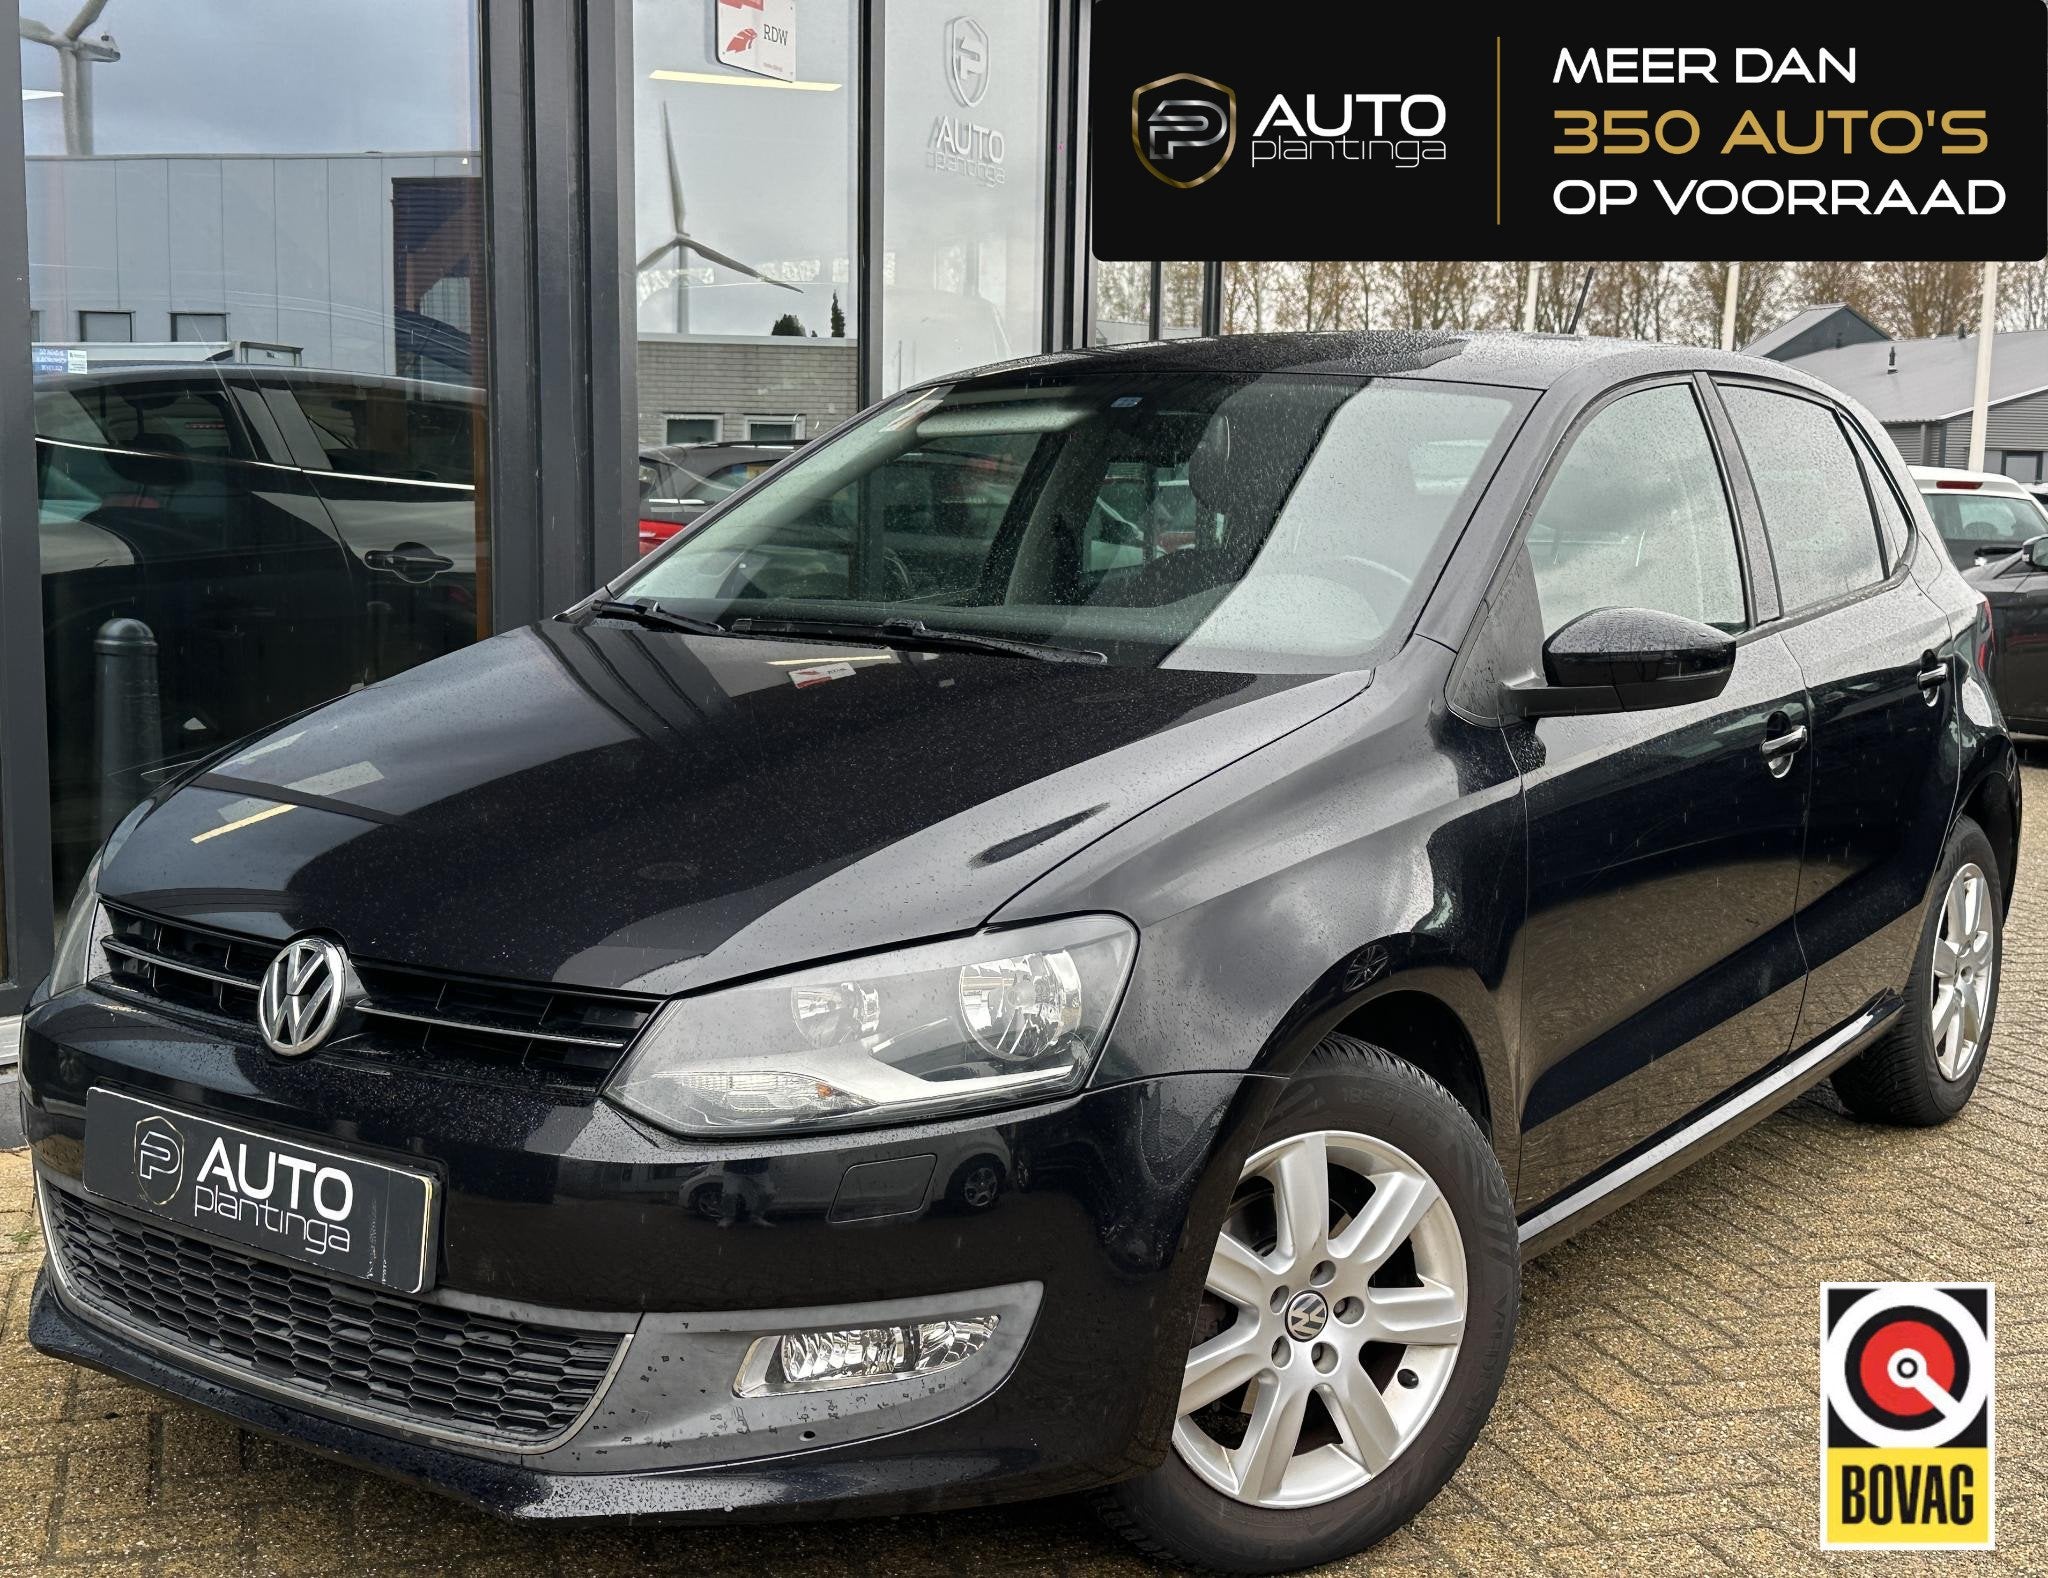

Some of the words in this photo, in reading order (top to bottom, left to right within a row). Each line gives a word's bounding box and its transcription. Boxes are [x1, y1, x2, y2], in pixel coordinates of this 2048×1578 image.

[763, 23, 789, 46] RDW
[936, 115, 1005, 164] AUTO
[196, 1136, 354, 1222] AUTO
[194, 1184, 351, 1255] plantinga
